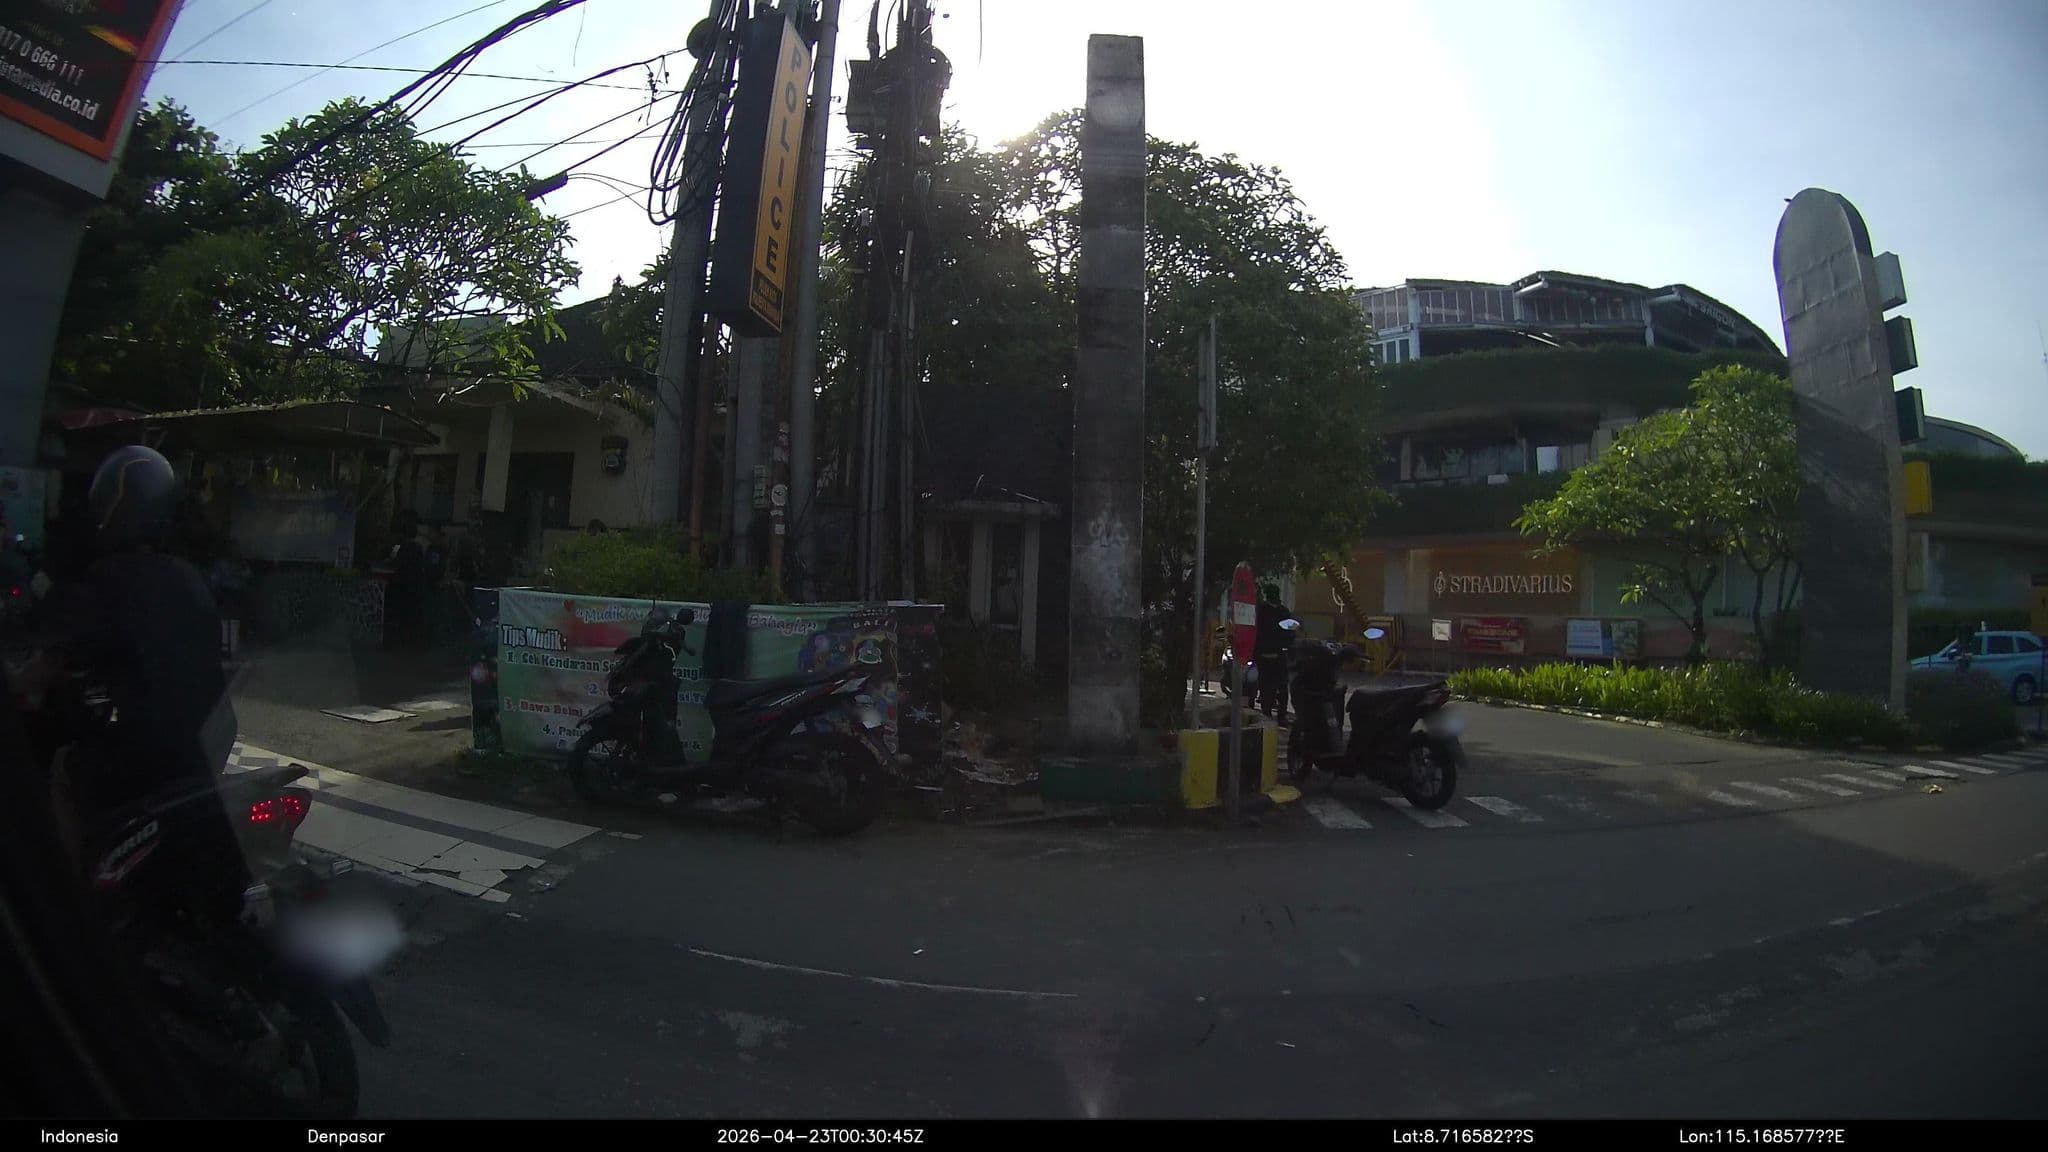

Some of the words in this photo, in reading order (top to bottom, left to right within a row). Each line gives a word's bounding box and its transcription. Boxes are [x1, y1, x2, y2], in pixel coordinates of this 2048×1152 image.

[31, 46, 58, 71] 666
[766, 49, 802, 274] POLICE
[1450, 575, 1573, 593] STRADIVARIUS
[501, 625, 526, 647] Tips
[541, 655, 600, 672] Kendaraan
